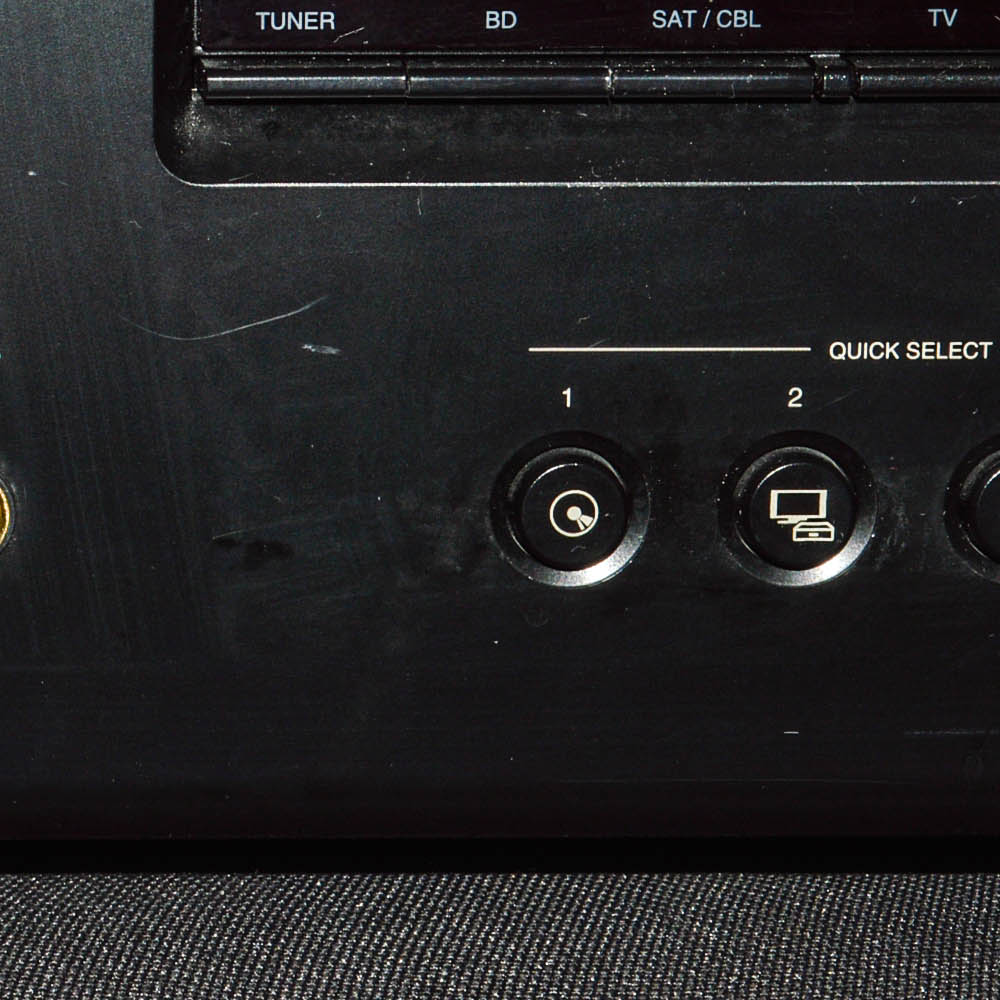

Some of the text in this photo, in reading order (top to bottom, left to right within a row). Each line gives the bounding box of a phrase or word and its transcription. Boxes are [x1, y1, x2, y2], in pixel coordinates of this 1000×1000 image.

[255, 11, 336, 31] TUNER
[485, 10, 518, 30] BD
[651, 9, 698, 29] SAT
[716, 9, 761, 29] CBL
[927, 8, 958, 28] TV
[829, 341, 994, 361] QUICK SELECT
[562, 387, 572, 408] 1
[787, 387, 803, 408] 2
